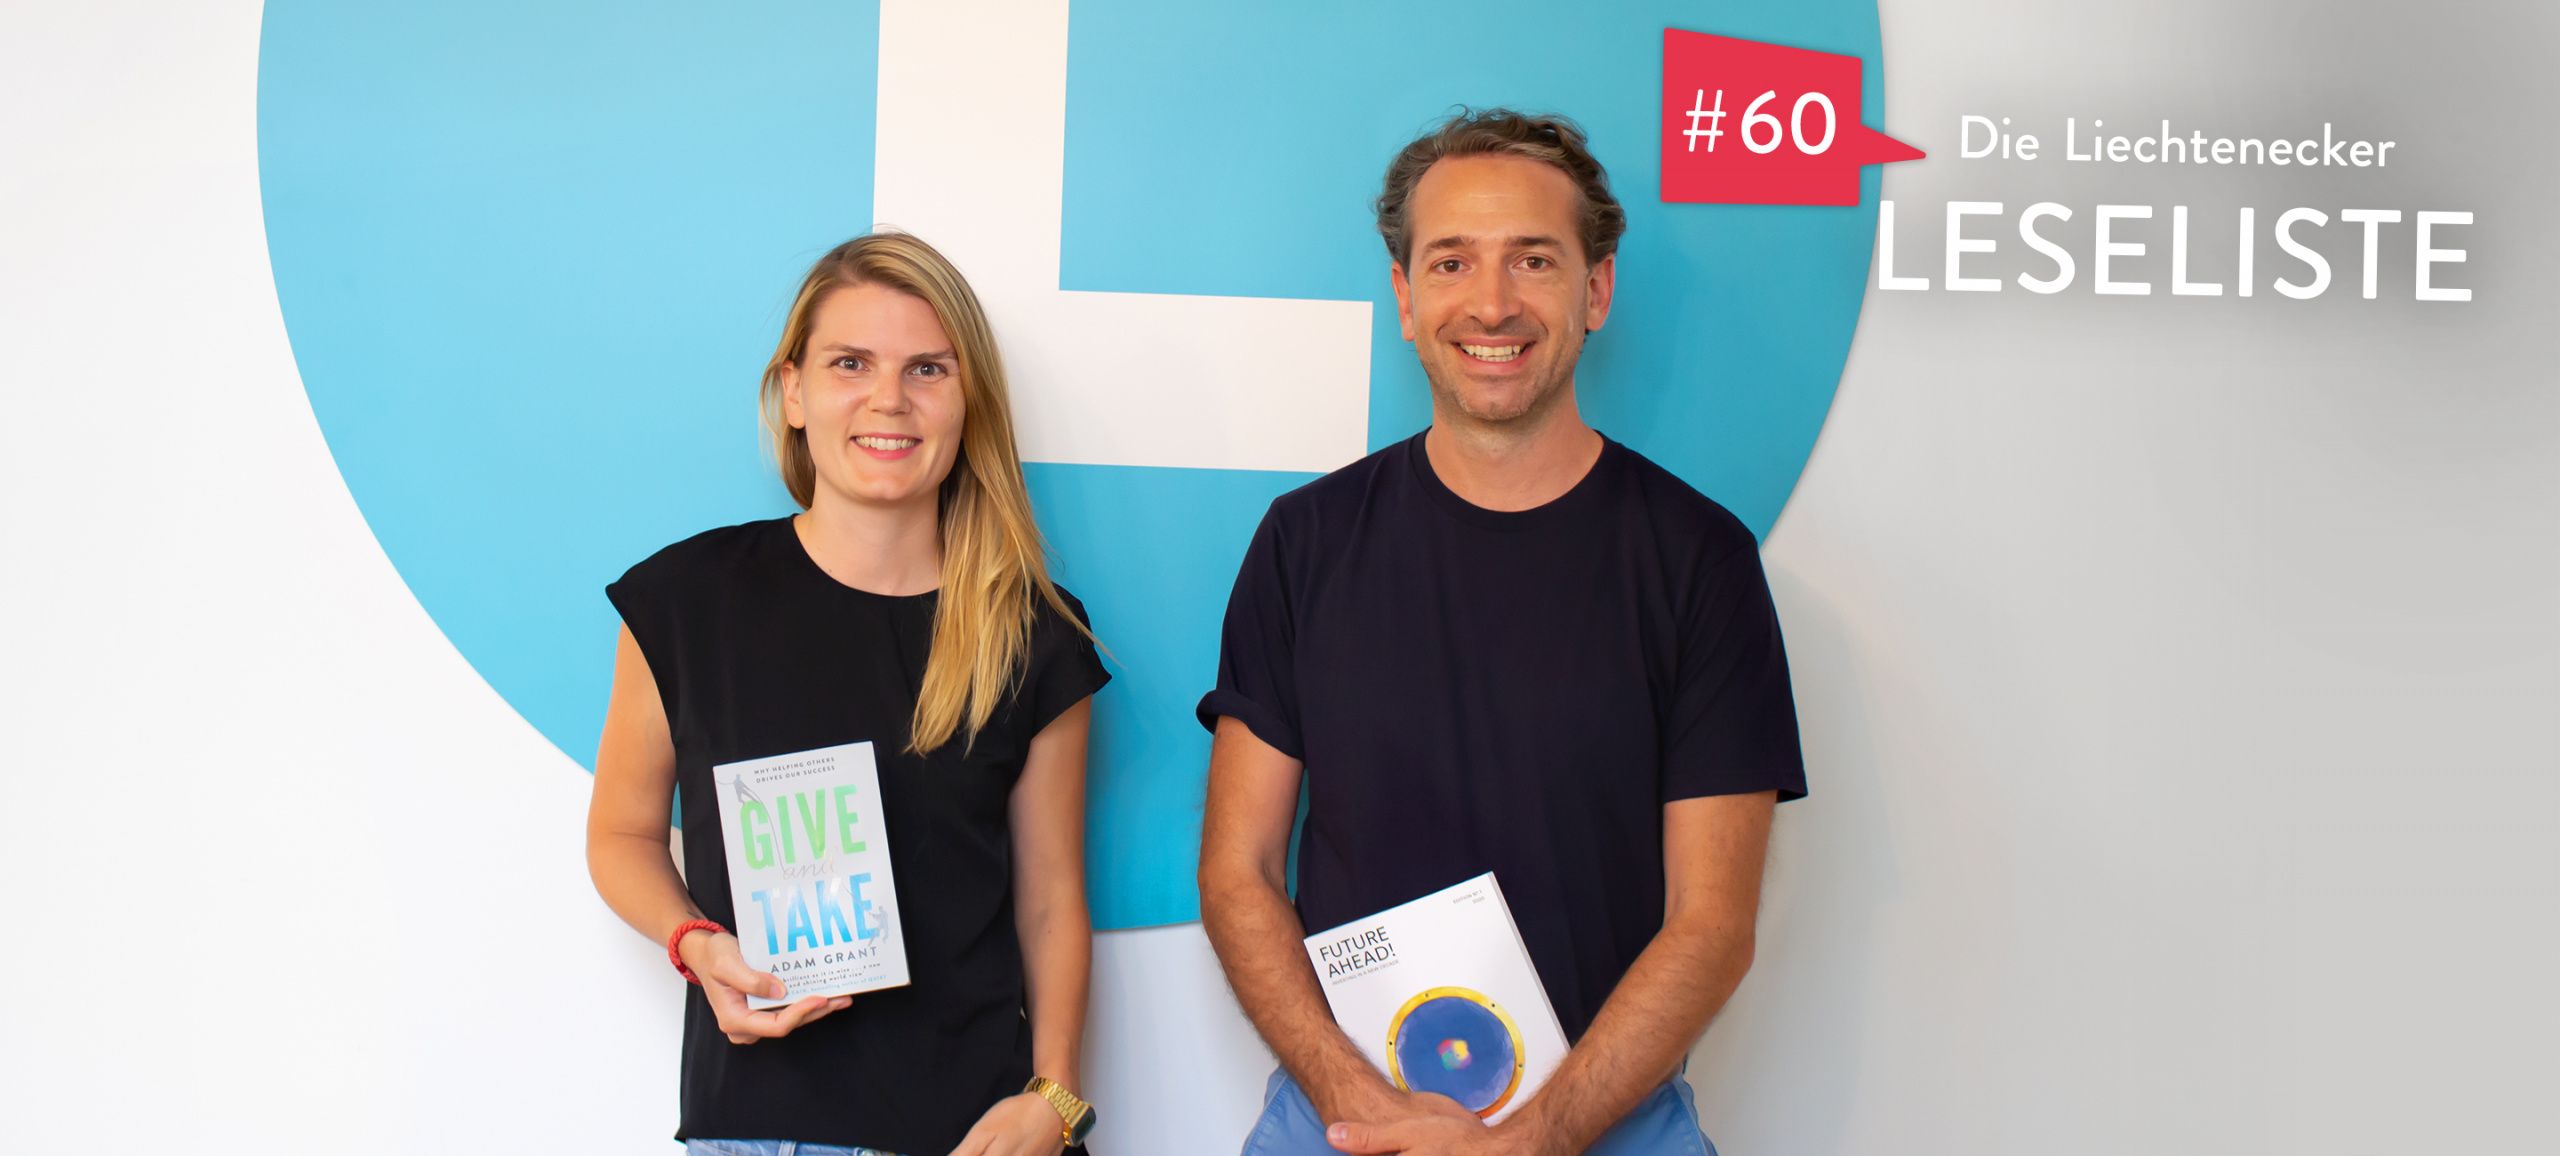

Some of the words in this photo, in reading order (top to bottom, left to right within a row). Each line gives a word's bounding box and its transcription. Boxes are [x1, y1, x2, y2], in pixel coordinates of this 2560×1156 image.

[754, 767, 769, 775] WHY
[772, 762, 804, 772] HELPING
[807, 757, 835, 766] OTHERS
[756, 774, 783, 784] DRIVES
[803, 765, 836, 776] SUCCESS
[740, 784, 867, 870] GIVE
[751, 873, 879, 956] TAKE
[770, 957, 816, 974] ADAM
[824, 946, 878, 965] GRANT
[1319, 926, 1389, 962] FUTURE
[1328, 943, 1396, 978] AHEAD!
